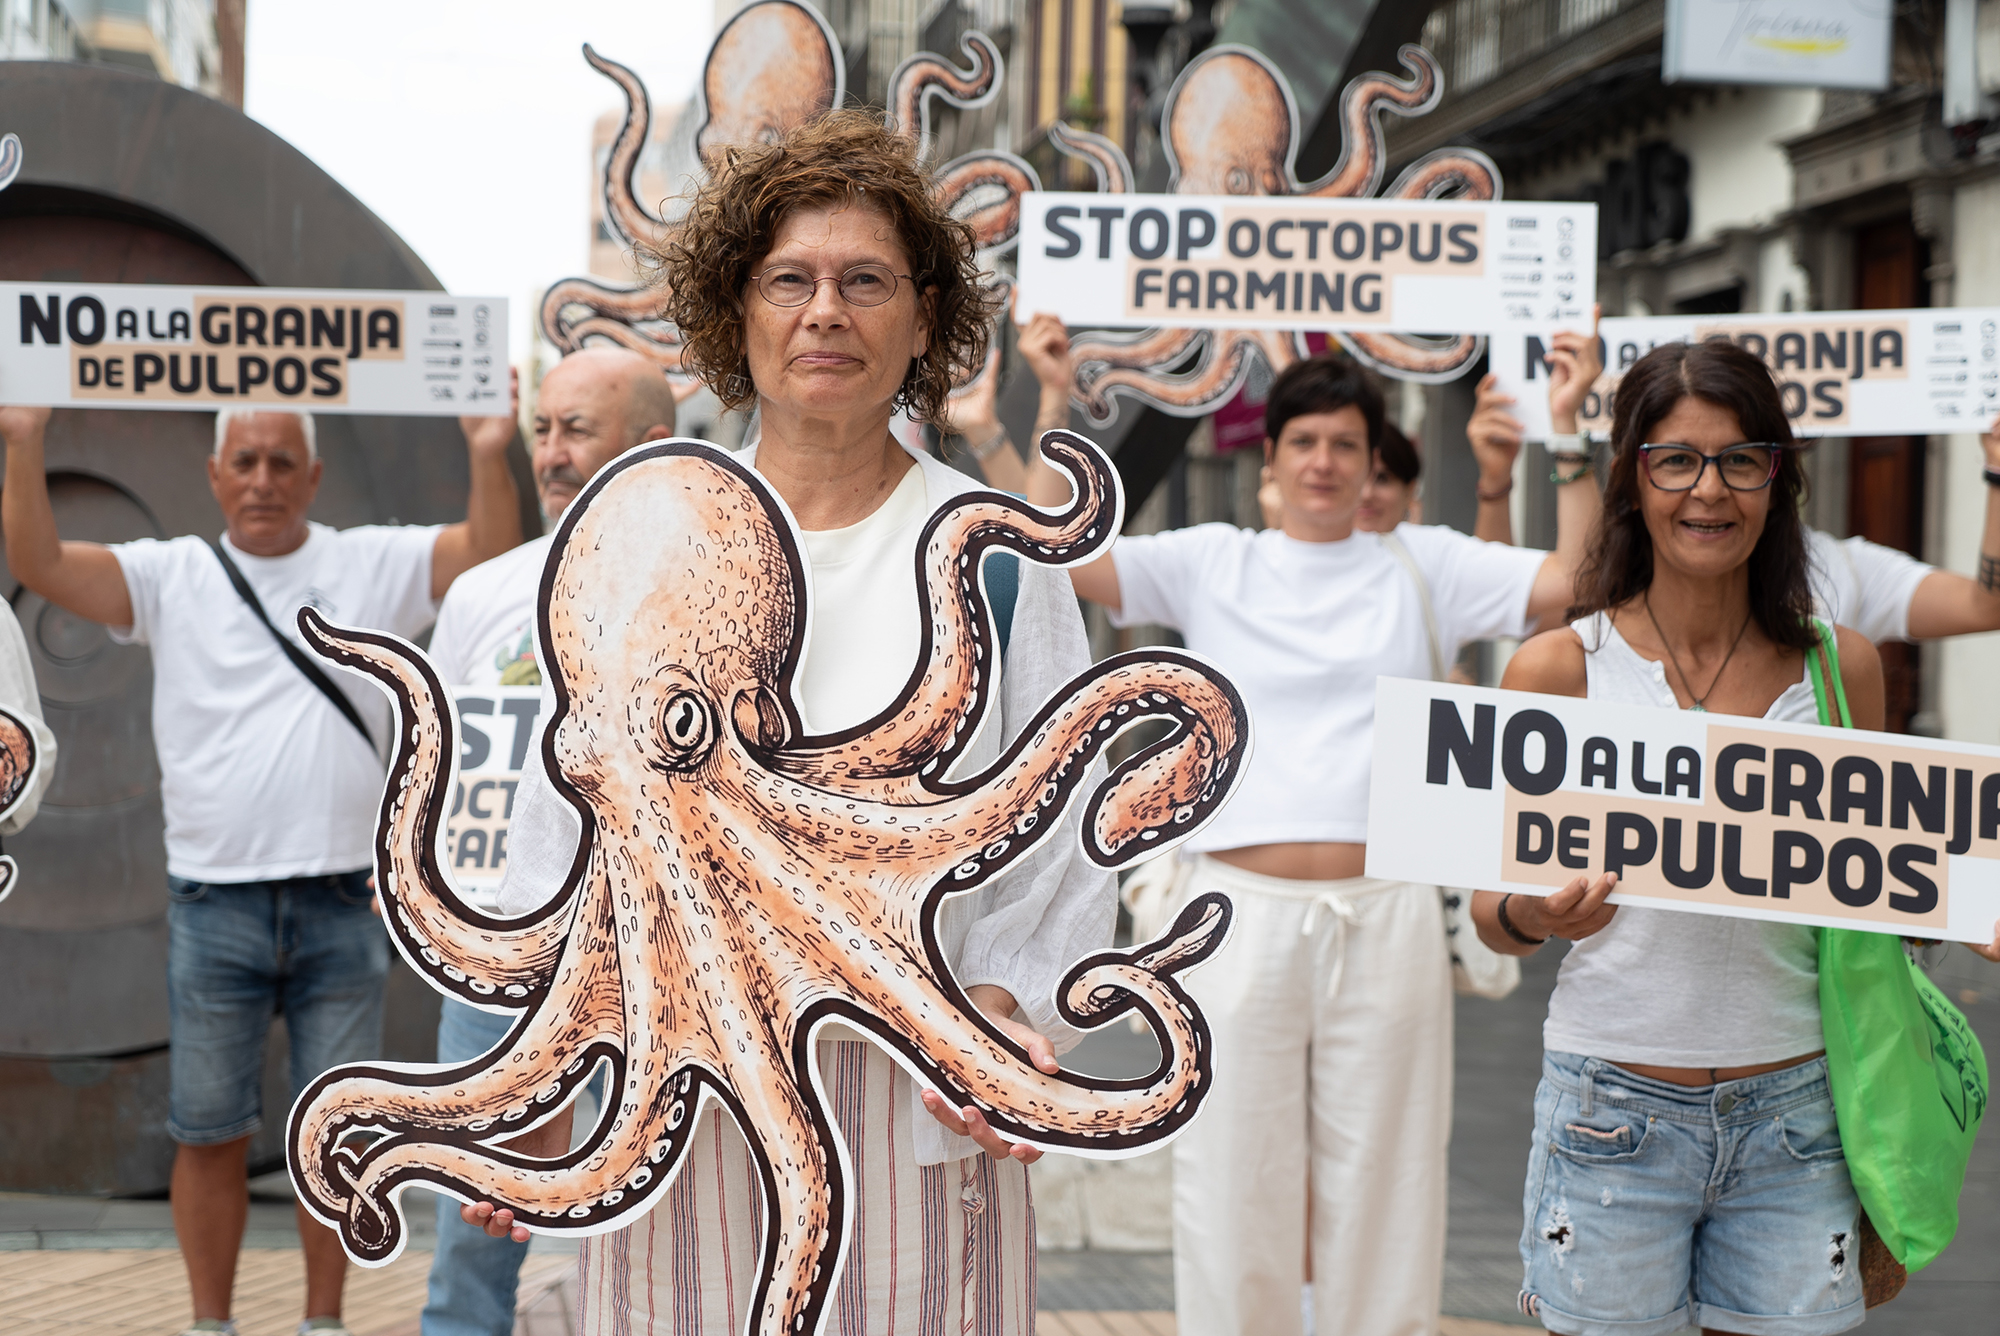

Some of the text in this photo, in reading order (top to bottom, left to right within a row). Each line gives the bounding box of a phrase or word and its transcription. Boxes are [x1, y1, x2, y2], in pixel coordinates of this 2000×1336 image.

[1044, 206, 1479, 264] STOP OCTOPUS
[1134, 268, 1382, 314] FARMING
[19, 294, 400, 360] NO A LA GRANJA
[78, 352, 343, 399] DE PULPOS
[1426, 698, 1568, 796] NO
[1580, 736, 1618, 790] A
[1631, 741, 1702, 799] LA
[1515, 811, 1939, 915] DE PULPOS
